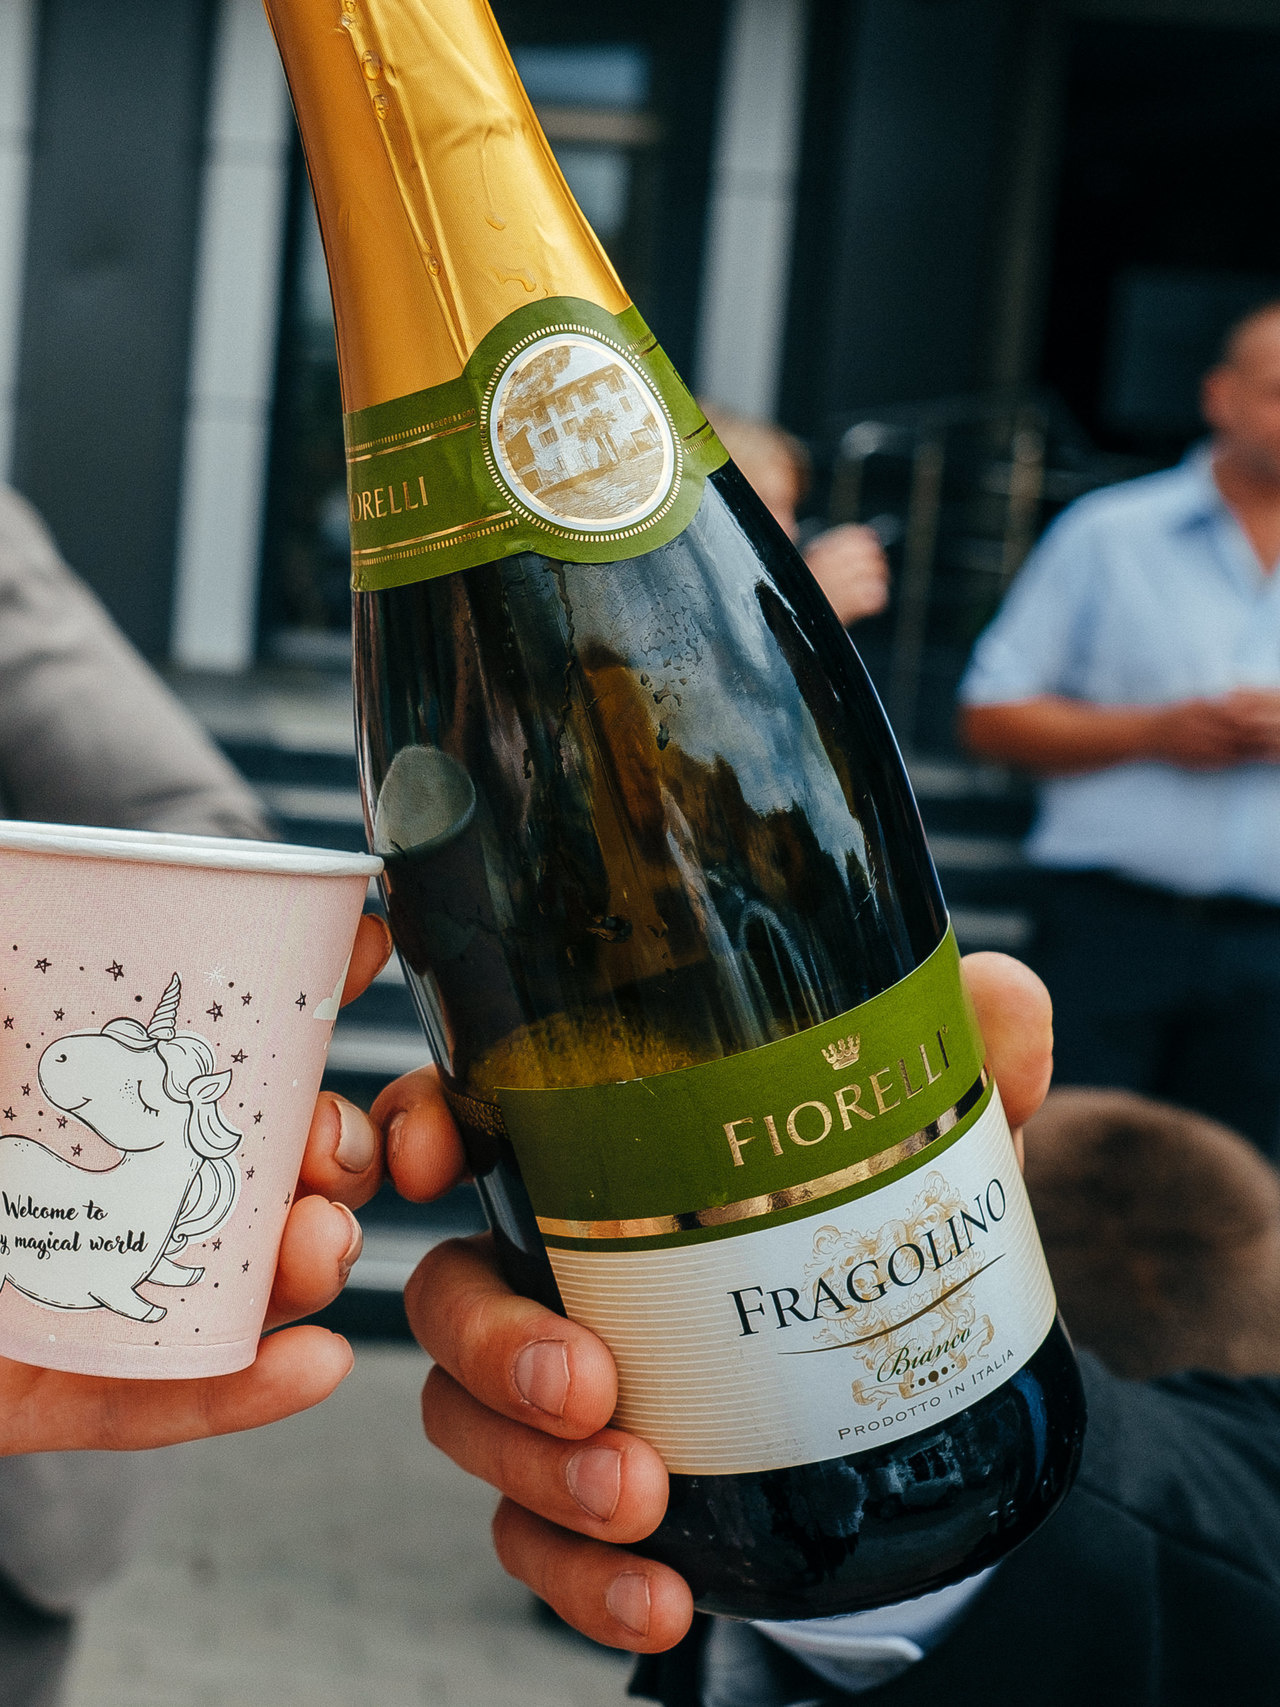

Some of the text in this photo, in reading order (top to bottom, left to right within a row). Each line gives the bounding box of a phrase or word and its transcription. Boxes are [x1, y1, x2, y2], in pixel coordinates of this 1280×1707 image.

[722, 1029, 950, 1167] FIORELLI
[1, 1191, 108, 1221] Welcome to
[15, 1231, 82, 1260] magical
[89, 1230, 149, 1254] world
[876, 1327, 971, 1383] Bianco
[838, 1349, 1014, 1440] PRODOTTO IN ITALIA
